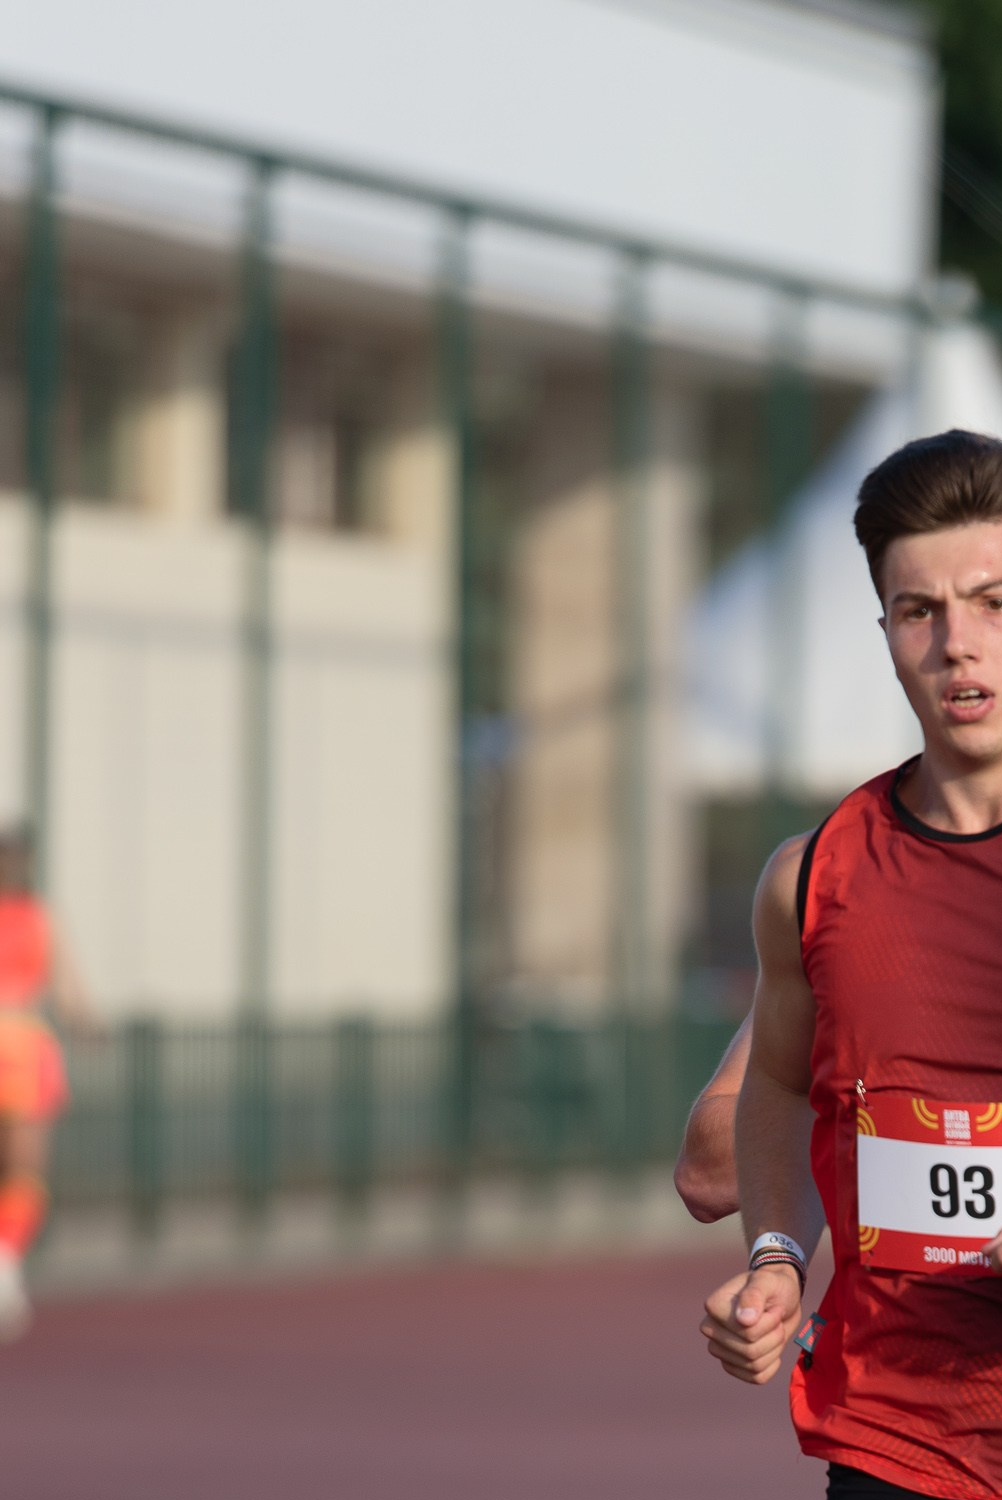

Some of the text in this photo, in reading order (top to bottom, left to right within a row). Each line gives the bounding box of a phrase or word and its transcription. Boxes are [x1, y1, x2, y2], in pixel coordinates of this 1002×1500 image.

[930, 1163, 996, 1220] 93
[769, 1234, 794, 1249] 036
[923, 1246, 956, 1264] 3000
